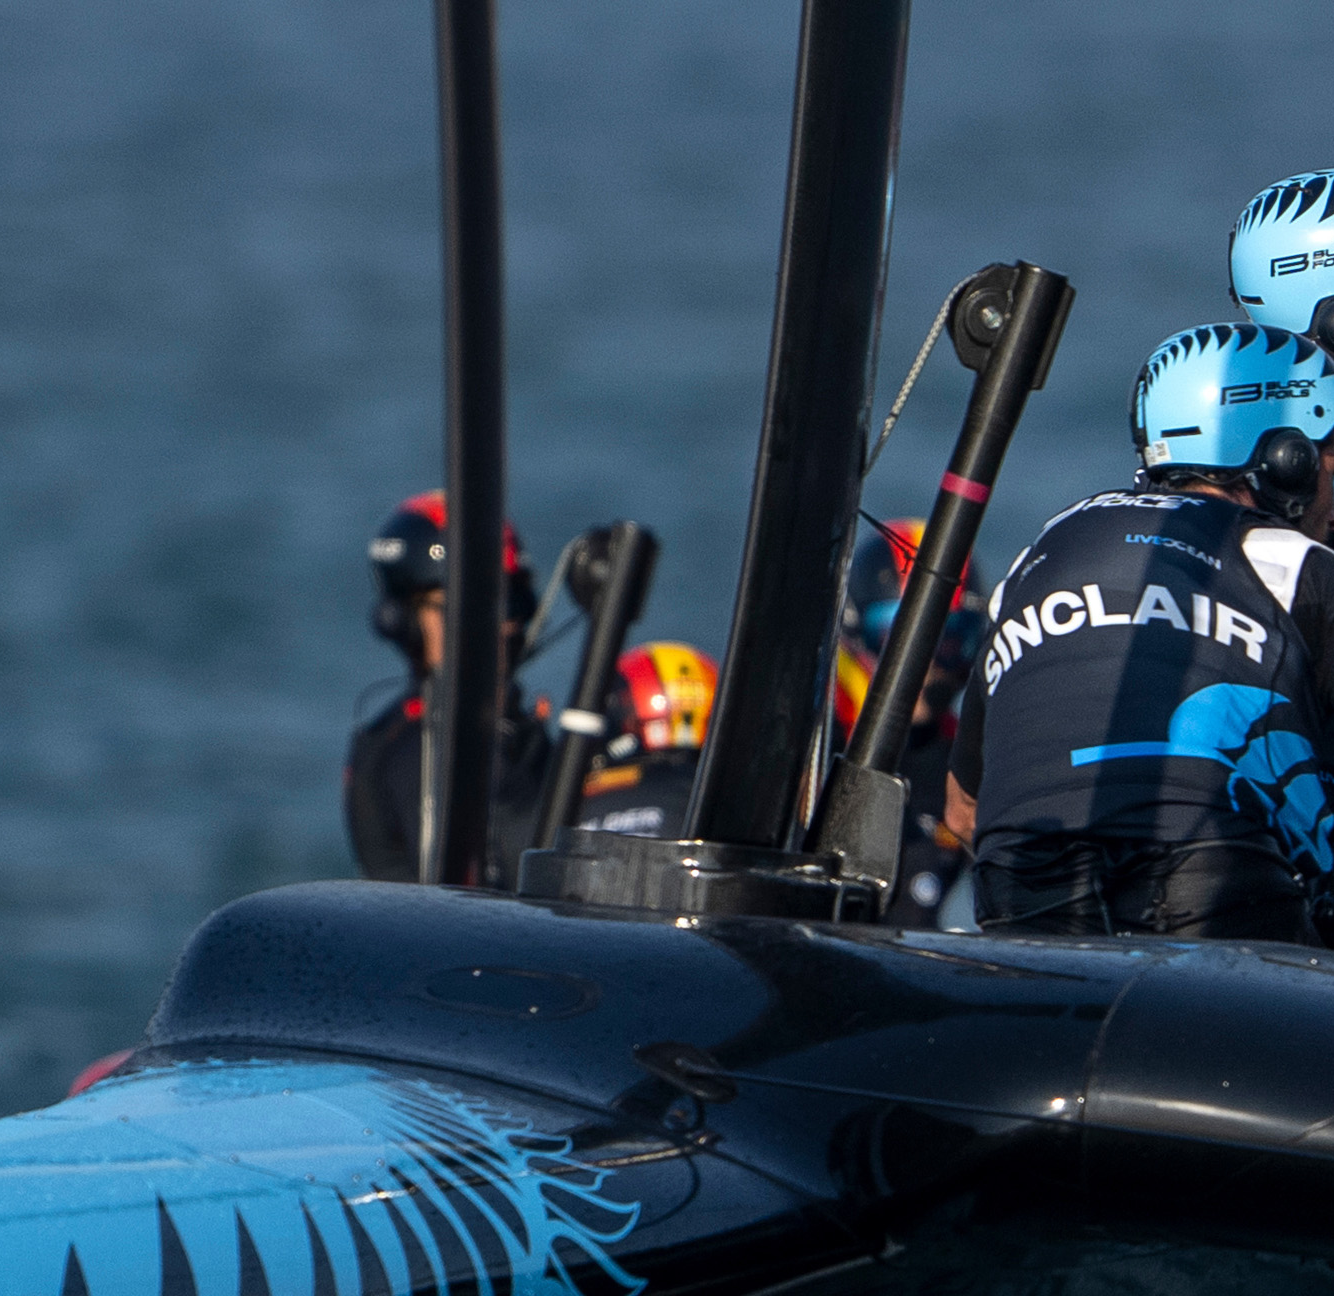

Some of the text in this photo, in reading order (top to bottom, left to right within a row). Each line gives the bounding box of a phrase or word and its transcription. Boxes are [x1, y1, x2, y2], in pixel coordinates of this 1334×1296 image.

[1265, 379, 1316, 390] BLACK
[1266, 388, 1310, 400] FOILS
[984, 584, 1268, 697] SINCLAIR
